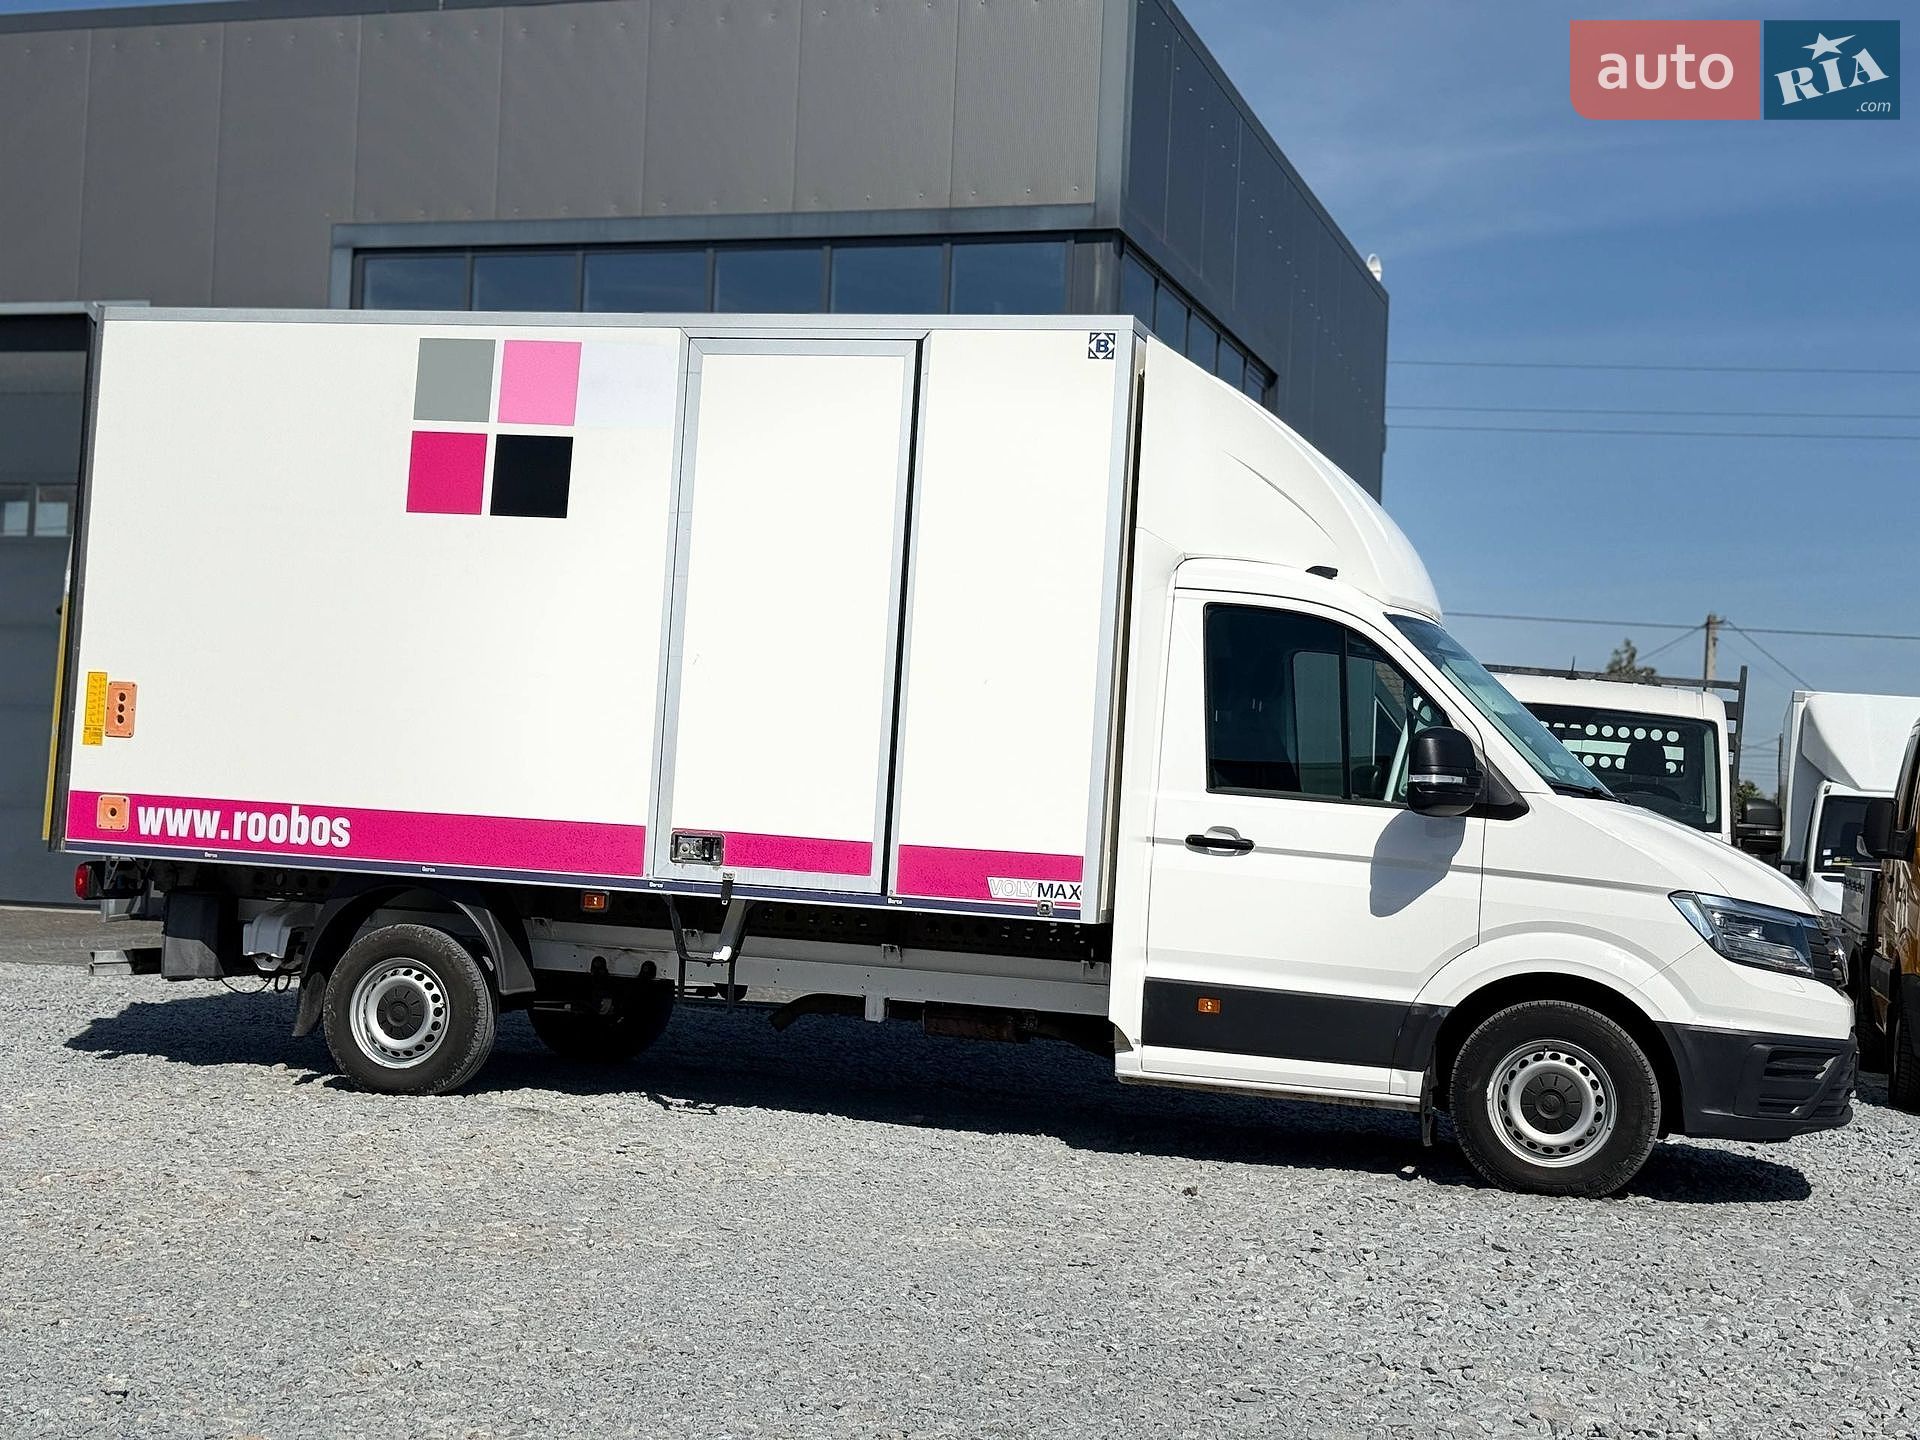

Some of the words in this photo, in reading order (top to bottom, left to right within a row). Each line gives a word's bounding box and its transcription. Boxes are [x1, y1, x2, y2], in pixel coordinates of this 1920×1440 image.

[1095, 338, 1110, 354] B
[137, 804, 351, 848] www.roobos
[989, 878, 1081, 901] VOLYMAX
